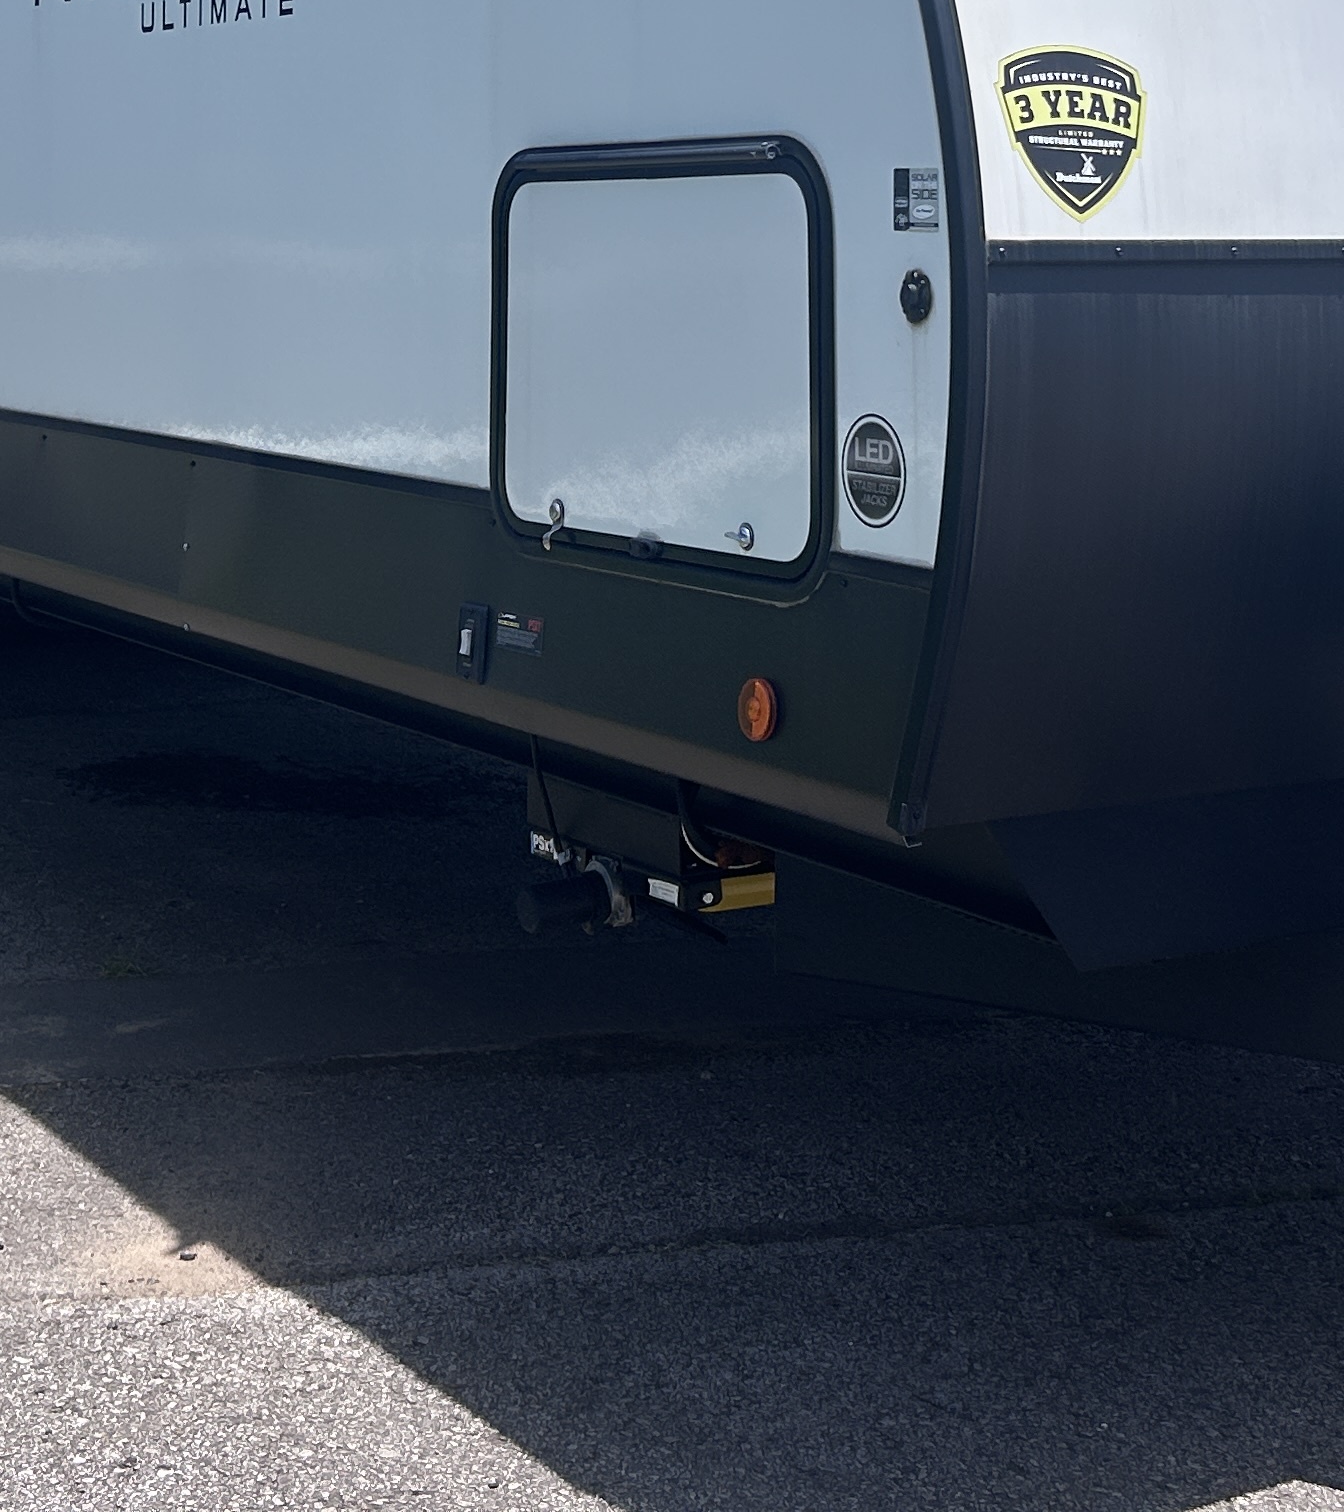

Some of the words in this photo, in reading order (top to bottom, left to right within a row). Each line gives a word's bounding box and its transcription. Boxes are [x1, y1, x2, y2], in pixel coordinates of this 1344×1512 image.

[1018, 72, 1089, 84] INDUSTRY'S
[1092, 76, 1122, 90] BEST
[1014, 94, 1035, 124] 3
[1042, 90, 1132, 130] YEAR
[911, 173, 938, 182] SOLAR
[911, 188, 938, 200] SIDE
[854, 436, 893, 465] LED
[852, 479, 896, 496] STABILIZER
[861, 493, 887, 506] JACKS
